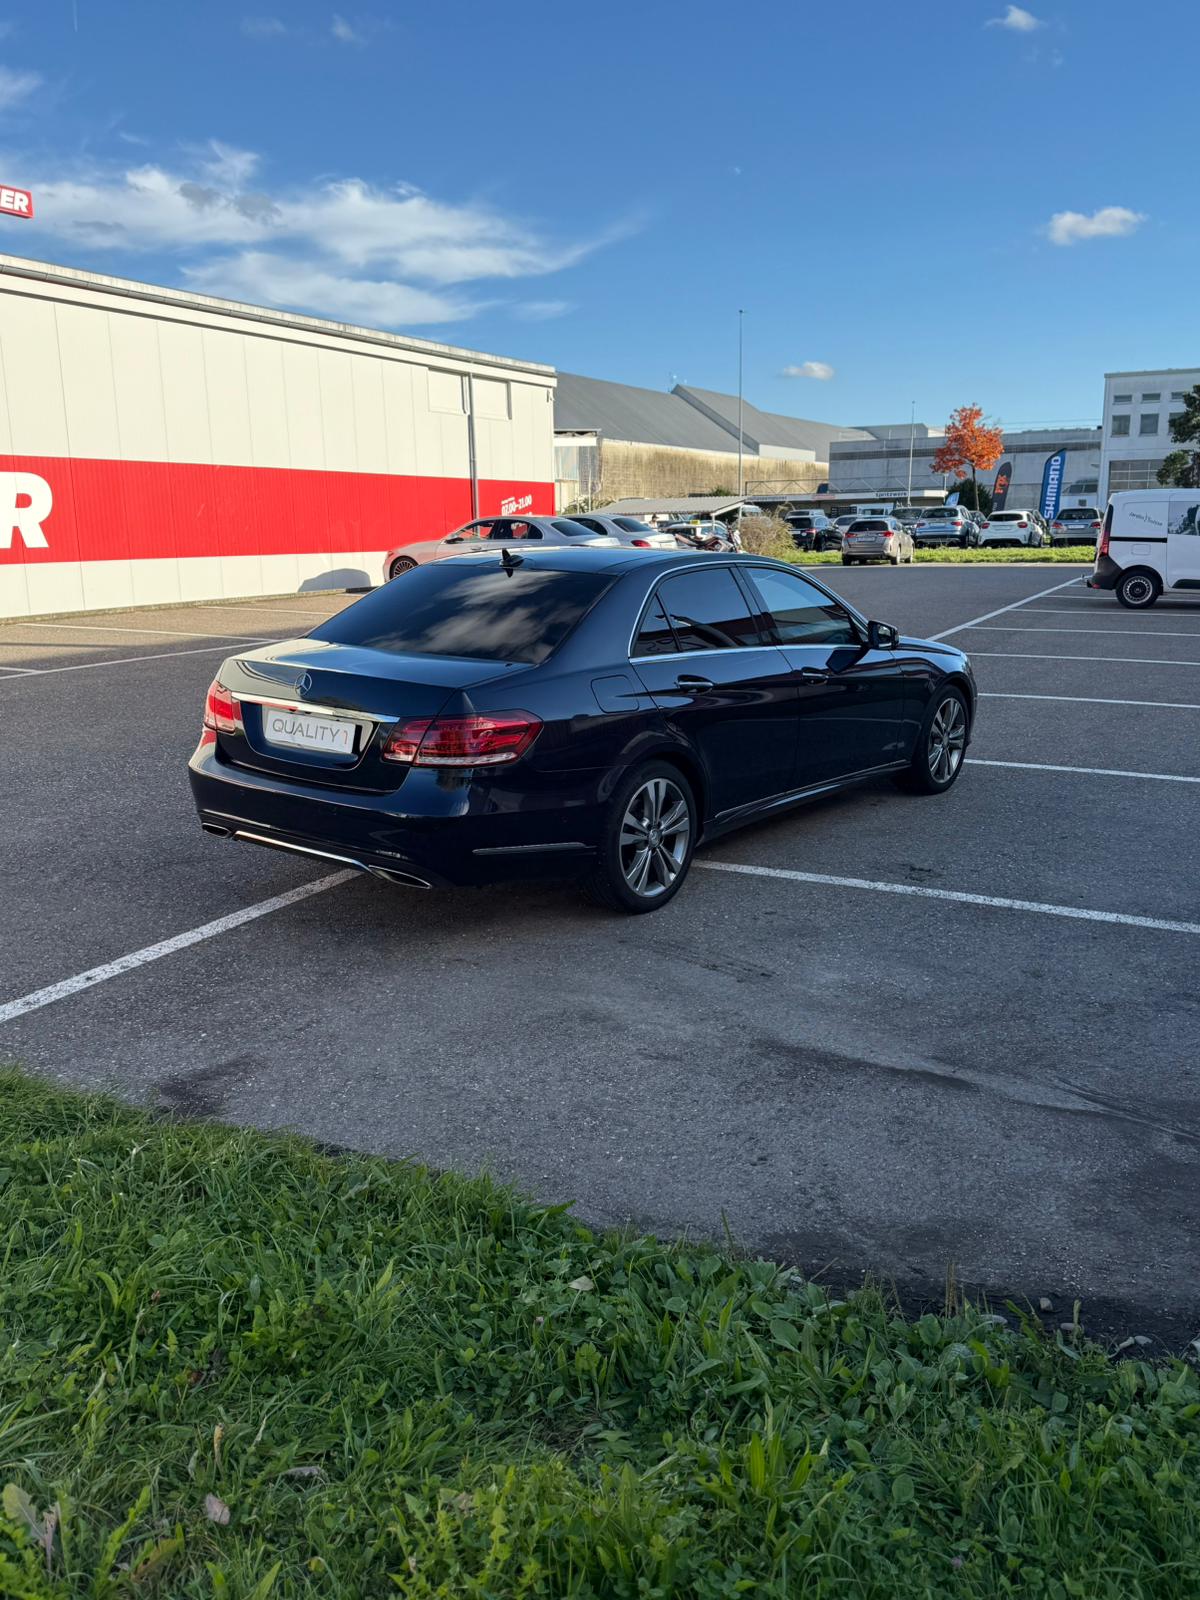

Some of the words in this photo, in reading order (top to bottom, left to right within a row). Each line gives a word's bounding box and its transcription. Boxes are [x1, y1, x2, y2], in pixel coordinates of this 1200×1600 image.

[0, 472, 53, 549] R
[1044, 455, 1061, 519] SHIMANO
[272, 718, 340, 742] QUALITY
